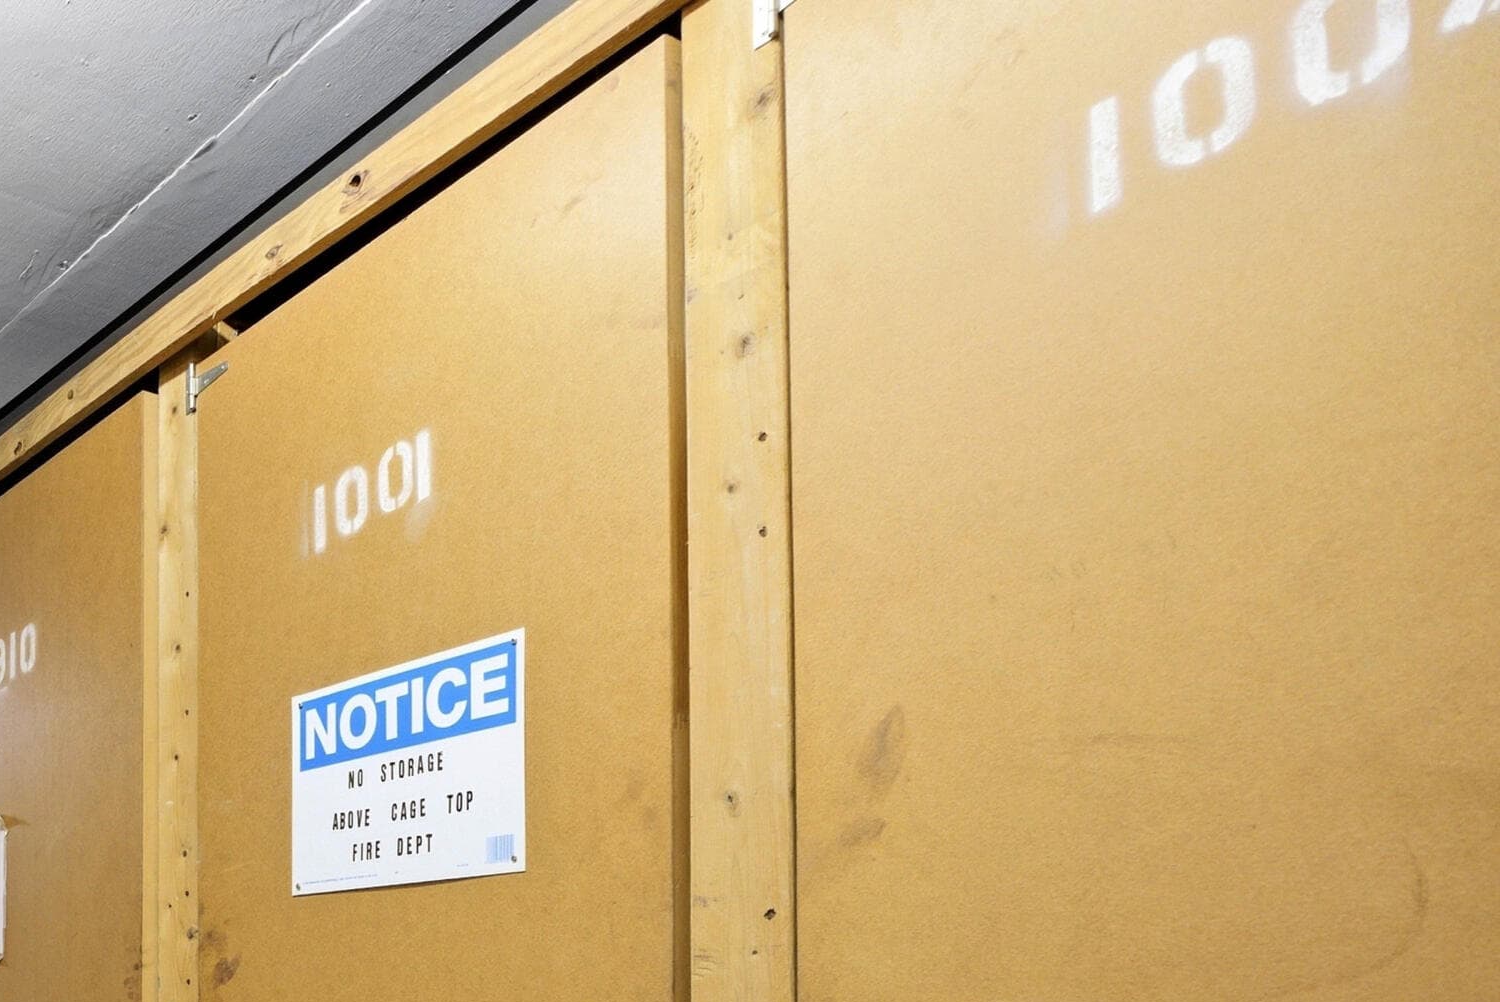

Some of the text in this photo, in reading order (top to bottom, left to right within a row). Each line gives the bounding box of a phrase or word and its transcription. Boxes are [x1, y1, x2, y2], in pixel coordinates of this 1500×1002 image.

[1088, 0, 1500, 216] 100
[313, 427, 432, 555] 1001
[304, 652, 510, 761] NOTICE
[347, 751, 445, 790] NO STORAGE
[332, 790, 475, 831] ABOVE CAGE TOP
[352, 833, 434, 863] FIRE DEPT
